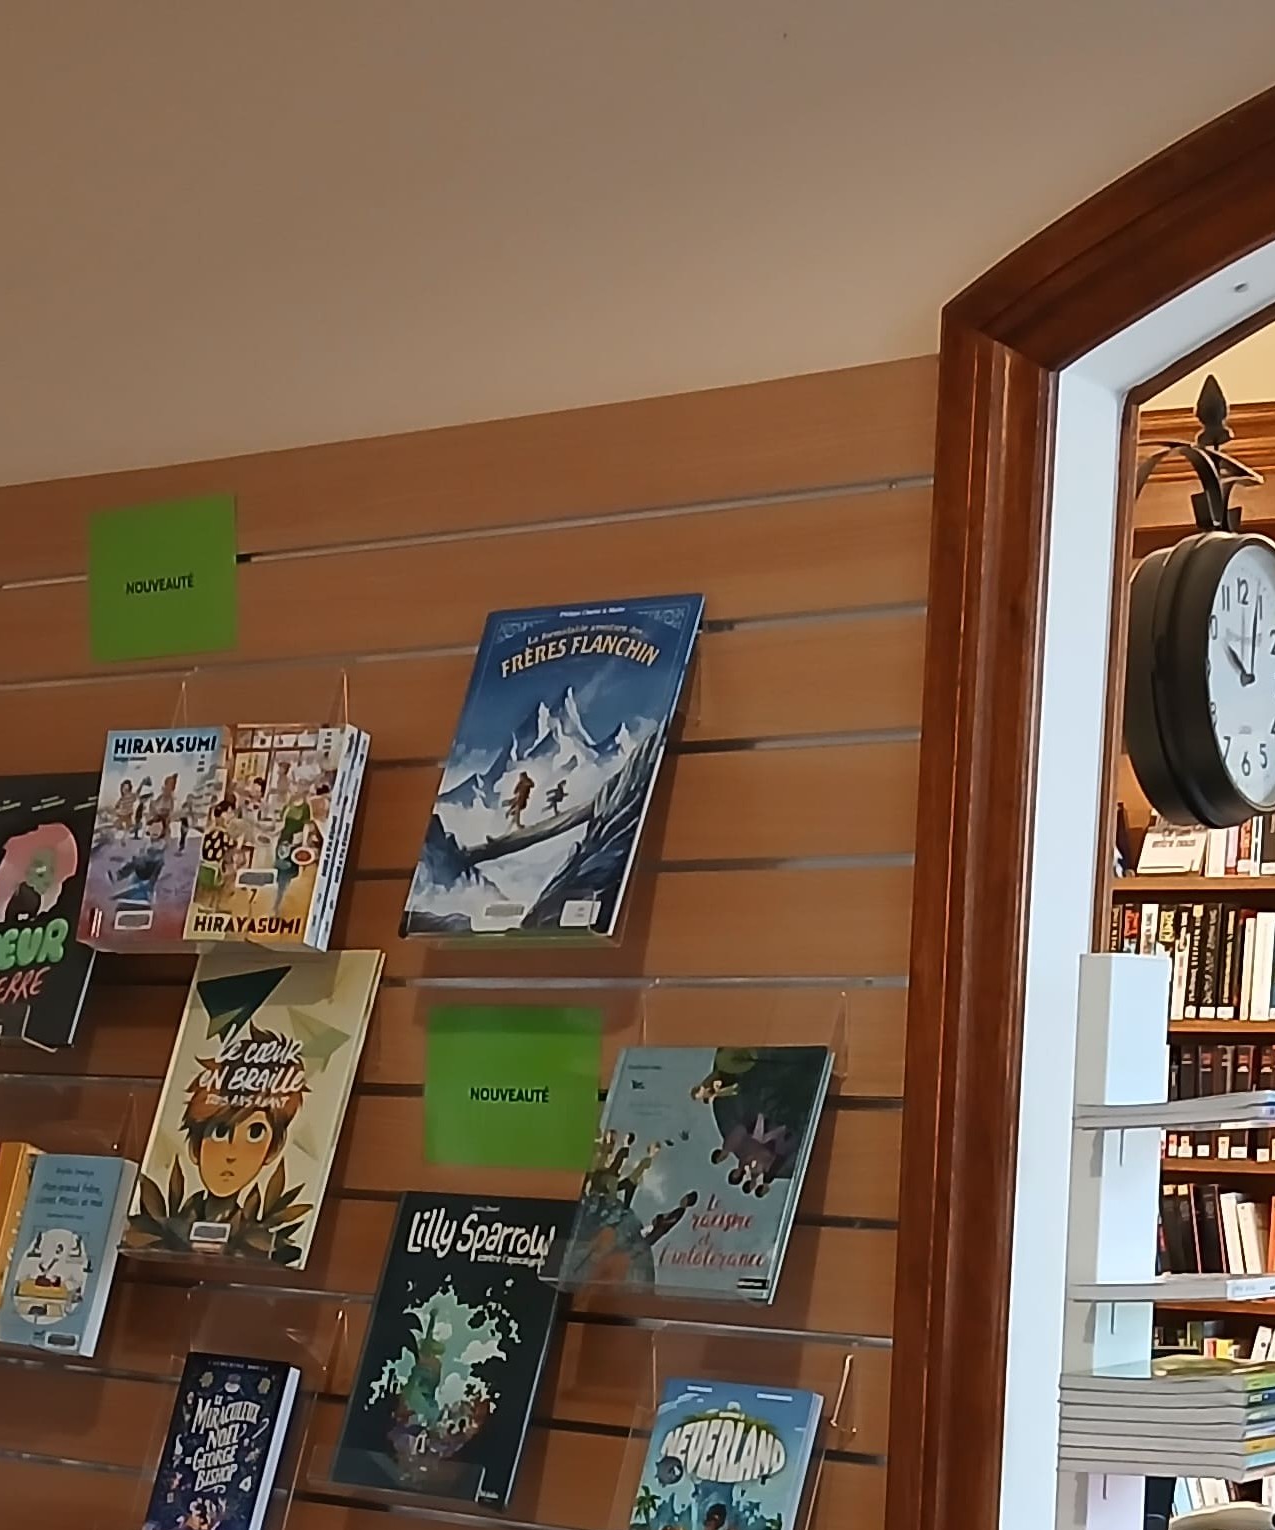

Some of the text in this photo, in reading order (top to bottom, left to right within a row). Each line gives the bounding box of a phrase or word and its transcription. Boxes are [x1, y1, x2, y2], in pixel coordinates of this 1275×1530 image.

[125, 572, 194, 595] NOUVEAUTÉ
[1237, 577, 1249, 605] 12
[1221, 585, 1231, 611] 11
[501, 635, 661, 679] FRÈRES FLANCHIN
[113, 735, 218, 757] HIRAYASUMI
[1259, 743, 1268, 770] 5
[1241, 751, 1251, 777] 6
[193, 915, 302, 935] HIRAYASUMI
[469, 1085, 550, 1104] NOUVEAUTÉ
[691, 1210, 755, 1232] racisme
[407, 1207, 556, 1262] Lilly Sparrow
[661, 1419, 786, 1483] NEVERLAND
